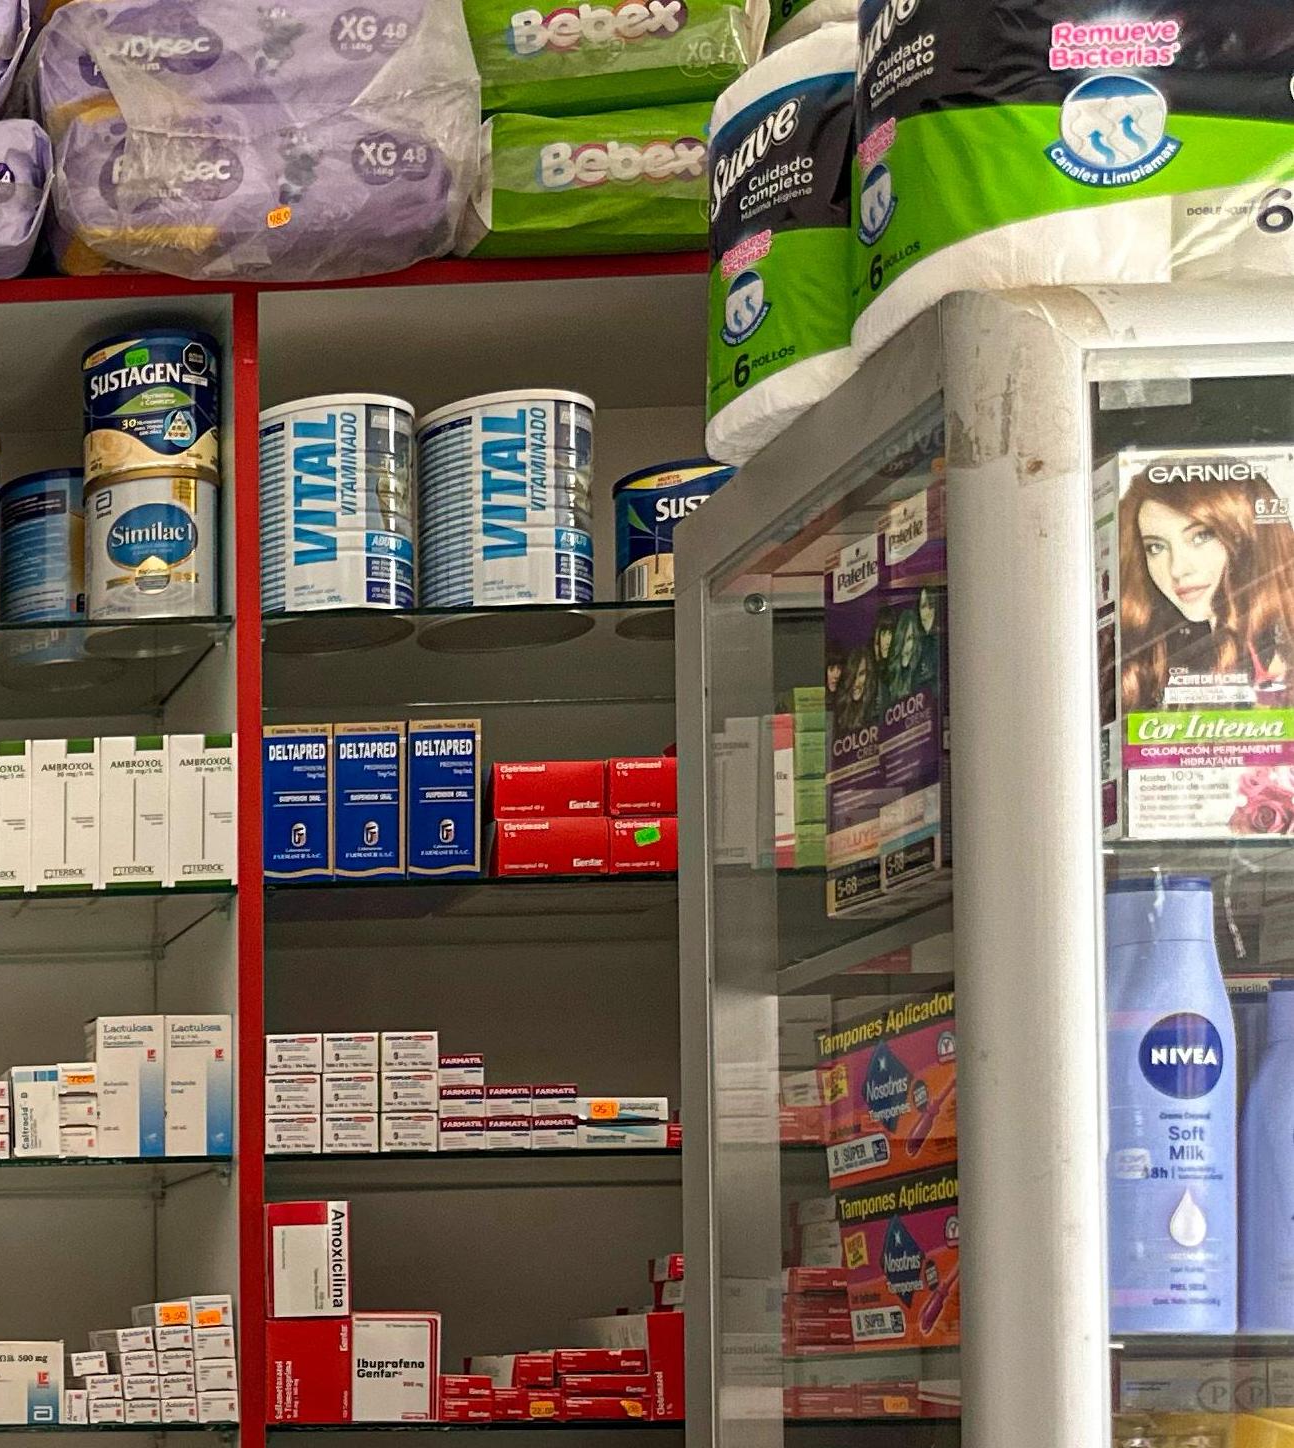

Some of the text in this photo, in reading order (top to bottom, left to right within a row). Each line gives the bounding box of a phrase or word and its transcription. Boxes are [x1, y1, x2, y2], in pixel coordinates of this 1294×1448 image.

[1051, 19, 1177, 47] Remueve
[1049, 43, 1180, 70] Bacterias
[540, 138, 707, 187] Bebex
[747, 156, 814, 191] Cuidado
[1049, 142, 1177, 186] Canales Limpiamax
[739, 173, 814, 211] Completo
[733, 345, 796, 388] 6 ROLLOS
[90, 362, 183, 400] SUSTAGEN
[340, 411, 358, 516] VITAMINADO
[1147, 463, 1269, 484] GARNIER
[292, 412, 339, 566] VITAL
[482, 407, 528, 561] VITAL
[111, 523, 183, 544] Similac
[836, 558, 879, 593] Palette
[832, 725, 880, 758] COLOR
[1137, 715, 1286, 742] Cor Intensa
[268, 742, 326, 761] DELTAPRED
[1140, 743, 1283, 757] COLORACIÓN PERMANENTE
[1179, 755, 1244, 768] HIDRATANTE
[817, 993, 954, 1057] Tampones Aplicador
[1151, 1046, 1217, 1067] NIVEA
[1168, 1125, 1205, 1142] Soft
[1168, 1144, 1205, 1161] Milk
[330, 1208, 345, 1309] Amoxicilina
[17, 1354, 34, 1363] 500
[356, 1357, 426, 1372] Ibuprofeno
[356, 1369, 400, 1379] Genfar
